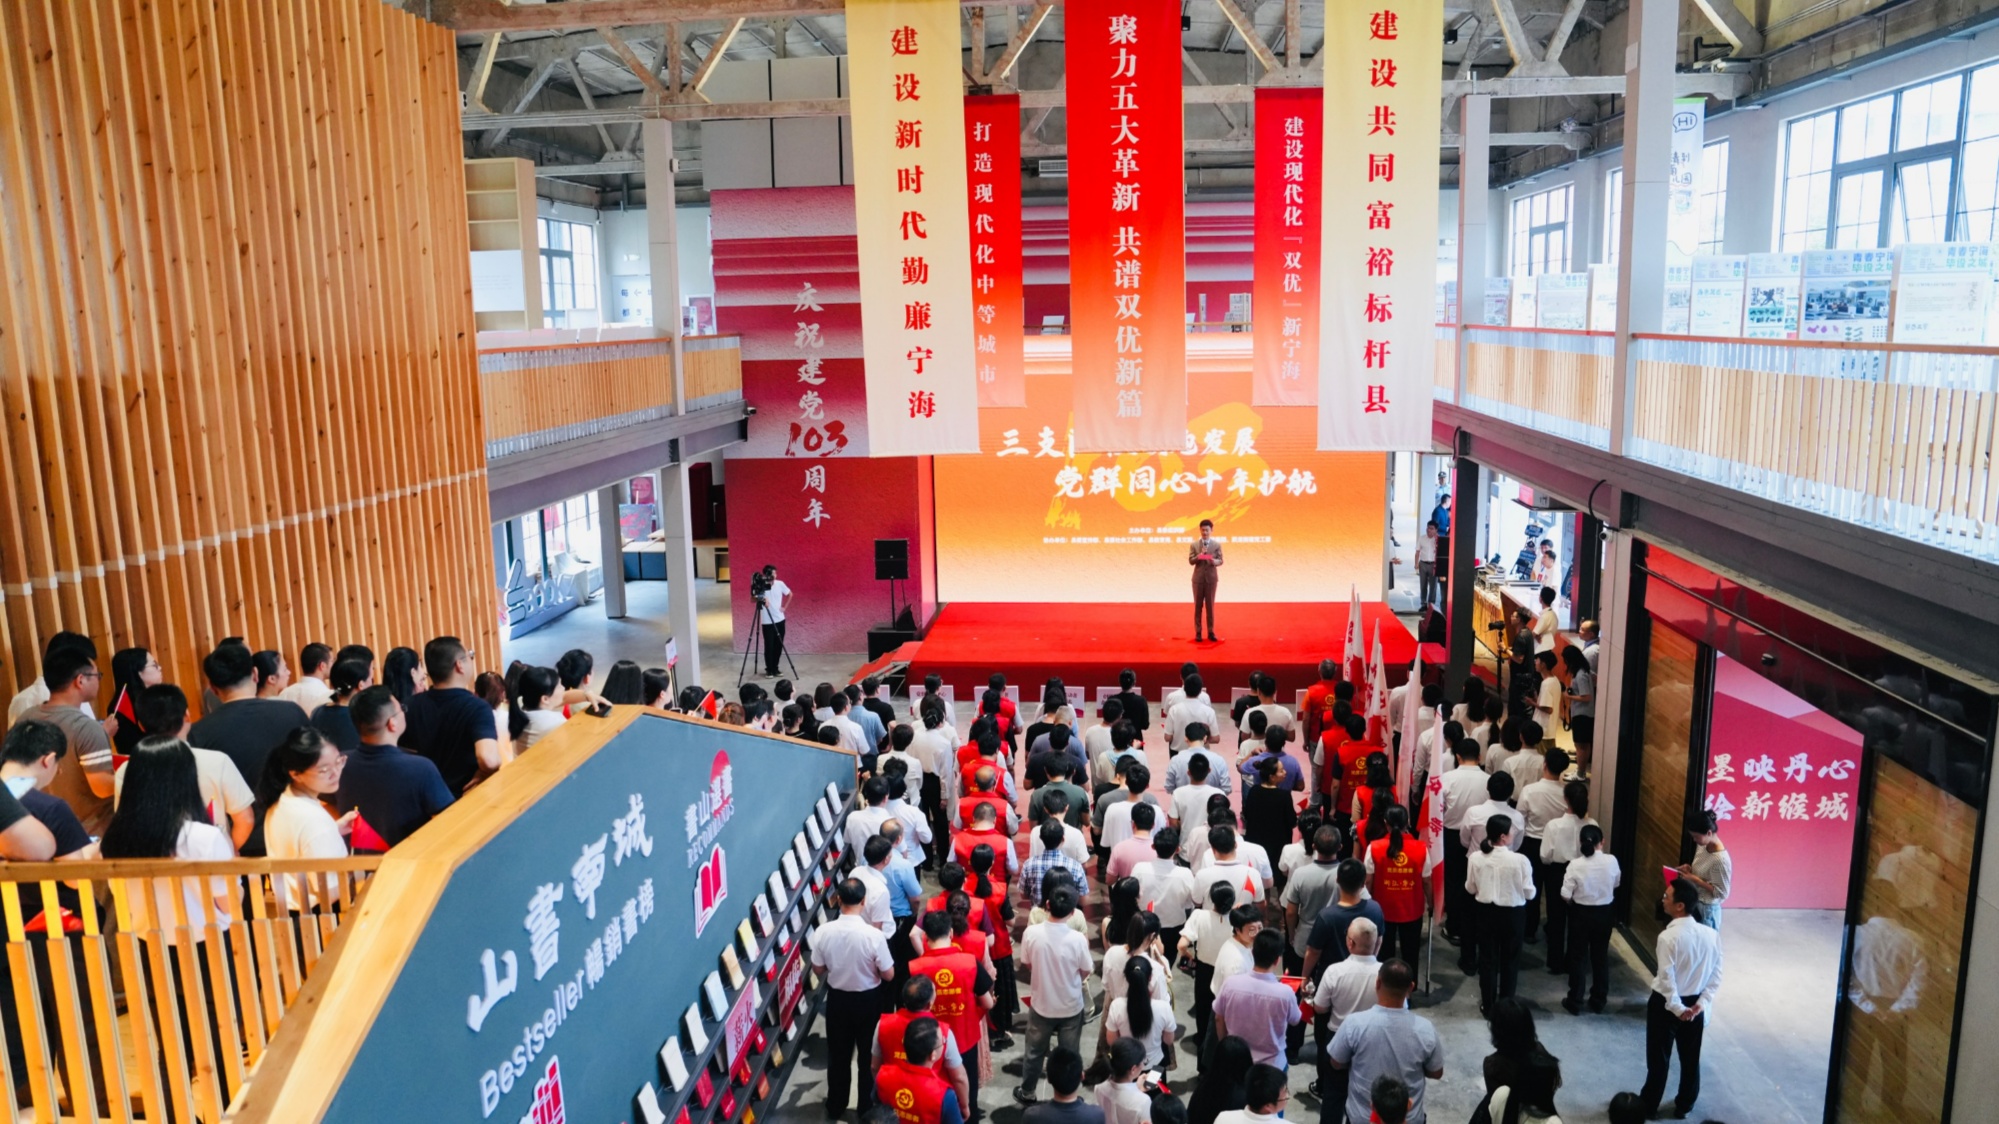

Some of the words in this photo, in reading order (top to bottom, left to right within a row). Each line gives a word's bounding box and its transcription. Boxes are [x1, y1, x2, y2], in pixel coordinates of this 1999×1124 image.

[890, 26, 936, 418] 建设新时代勤廉宁海
[973, 122, 996, 385] 打造现代化中等城市
[1362, 10, 1398, 415] 建设共同富裕标杆县
[1054, 465, 1318, 498] 党群同心十年护航
[1707, 752, 1856, 783] 墨映丹心
[479, 969, 585, 1119] Bestseller
